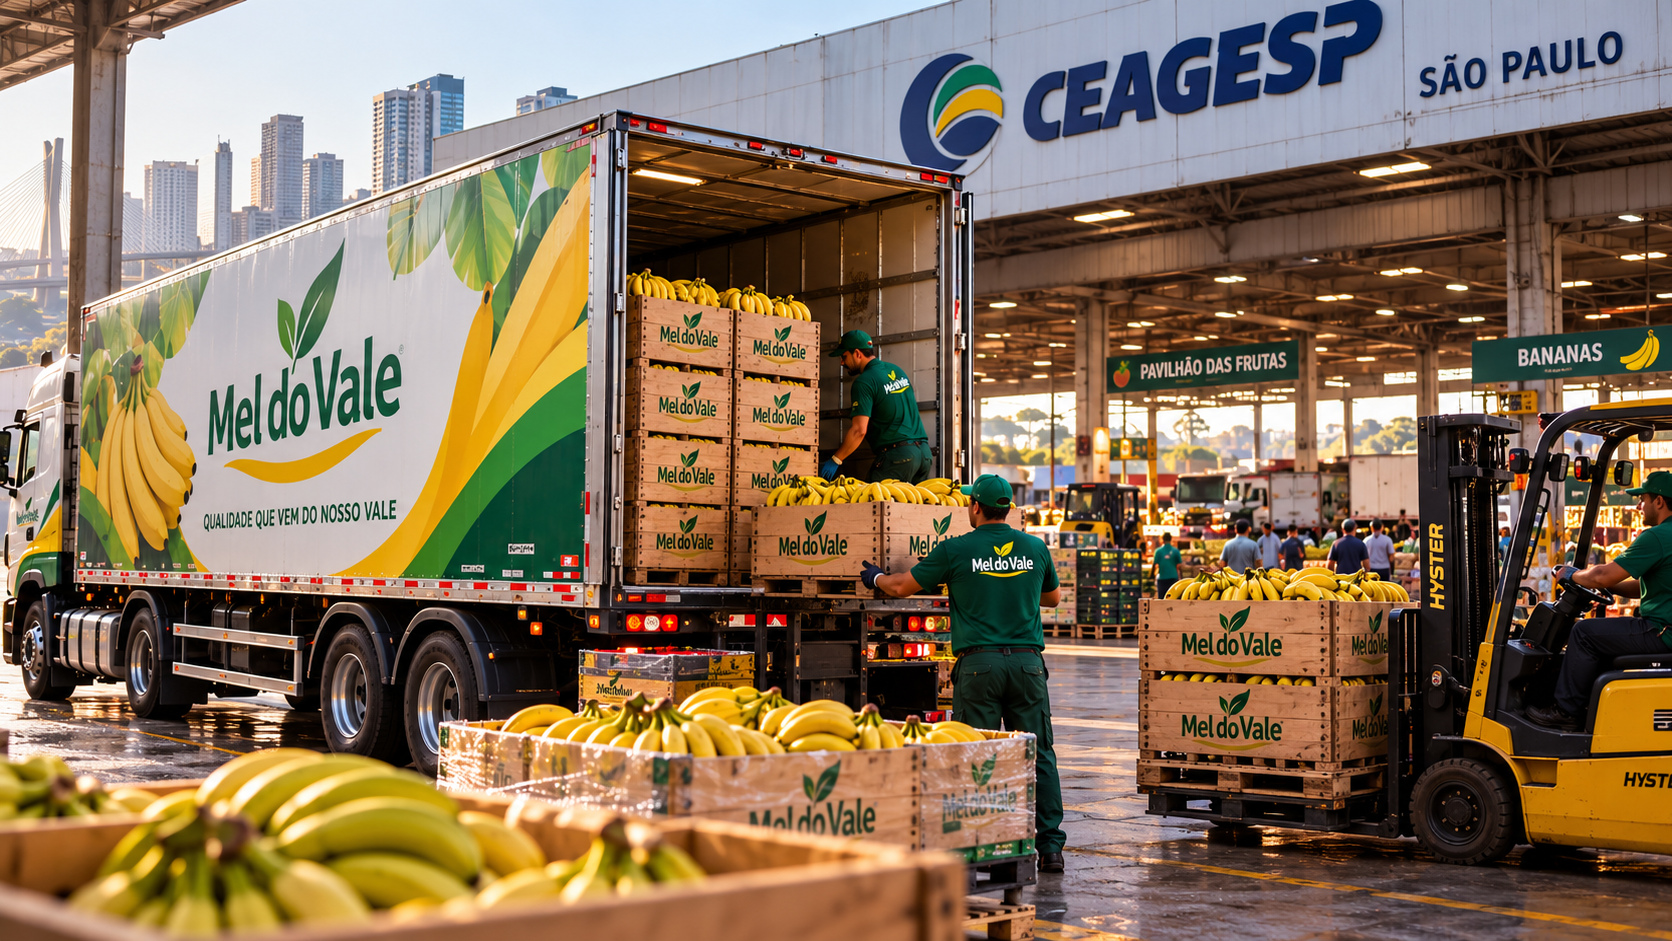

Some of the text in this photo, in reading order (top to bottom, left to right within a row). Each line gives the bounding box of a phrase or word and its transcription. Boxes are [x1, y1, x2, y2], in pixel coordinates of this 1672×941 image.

[1022, 0, 1382, 142] CEAGESP
[1419, 31, 1624, 98] SÃO PAULO
[660, 325, 718, 348] Mel do Vale
[753, 340, 806, 359] Mel do Vale
[1517, 343, 1603, 367] BANANAS
[1140, 352, 1287, 380] PAVILHÃO DAS FRUTAS
[208, 336, 402, 455] Mel do Vale
[659, 396, 716, 417] Mel do Vale
[753, 407, 805, 426] Mel do Vale
[658, 466, 714, 485] Mel do Vale
[752, 473, 769, 489] Mel
[203, 500, 397, 531] QUALIDADE QUE VEM DO NOSSO VALE
[656, 533, 714, 550] Mel do Vale
[779, 534, 848, 556] Mel do Vale
[909, 534, 930, 556] Mel
[972, 555, 1033, 572] Mel do Vale
[1428, 523, 1445, 610] HYSTER
[1182, 632, 1282, 657] Mel do Vale
[1352, 633, 1388, 656] Mel do Va
[1182, 714, 1282, 741] Mel do Vale
[1352, 715, 1388, 740] Mel do Va
[827, 798, 876, 836] Vale
